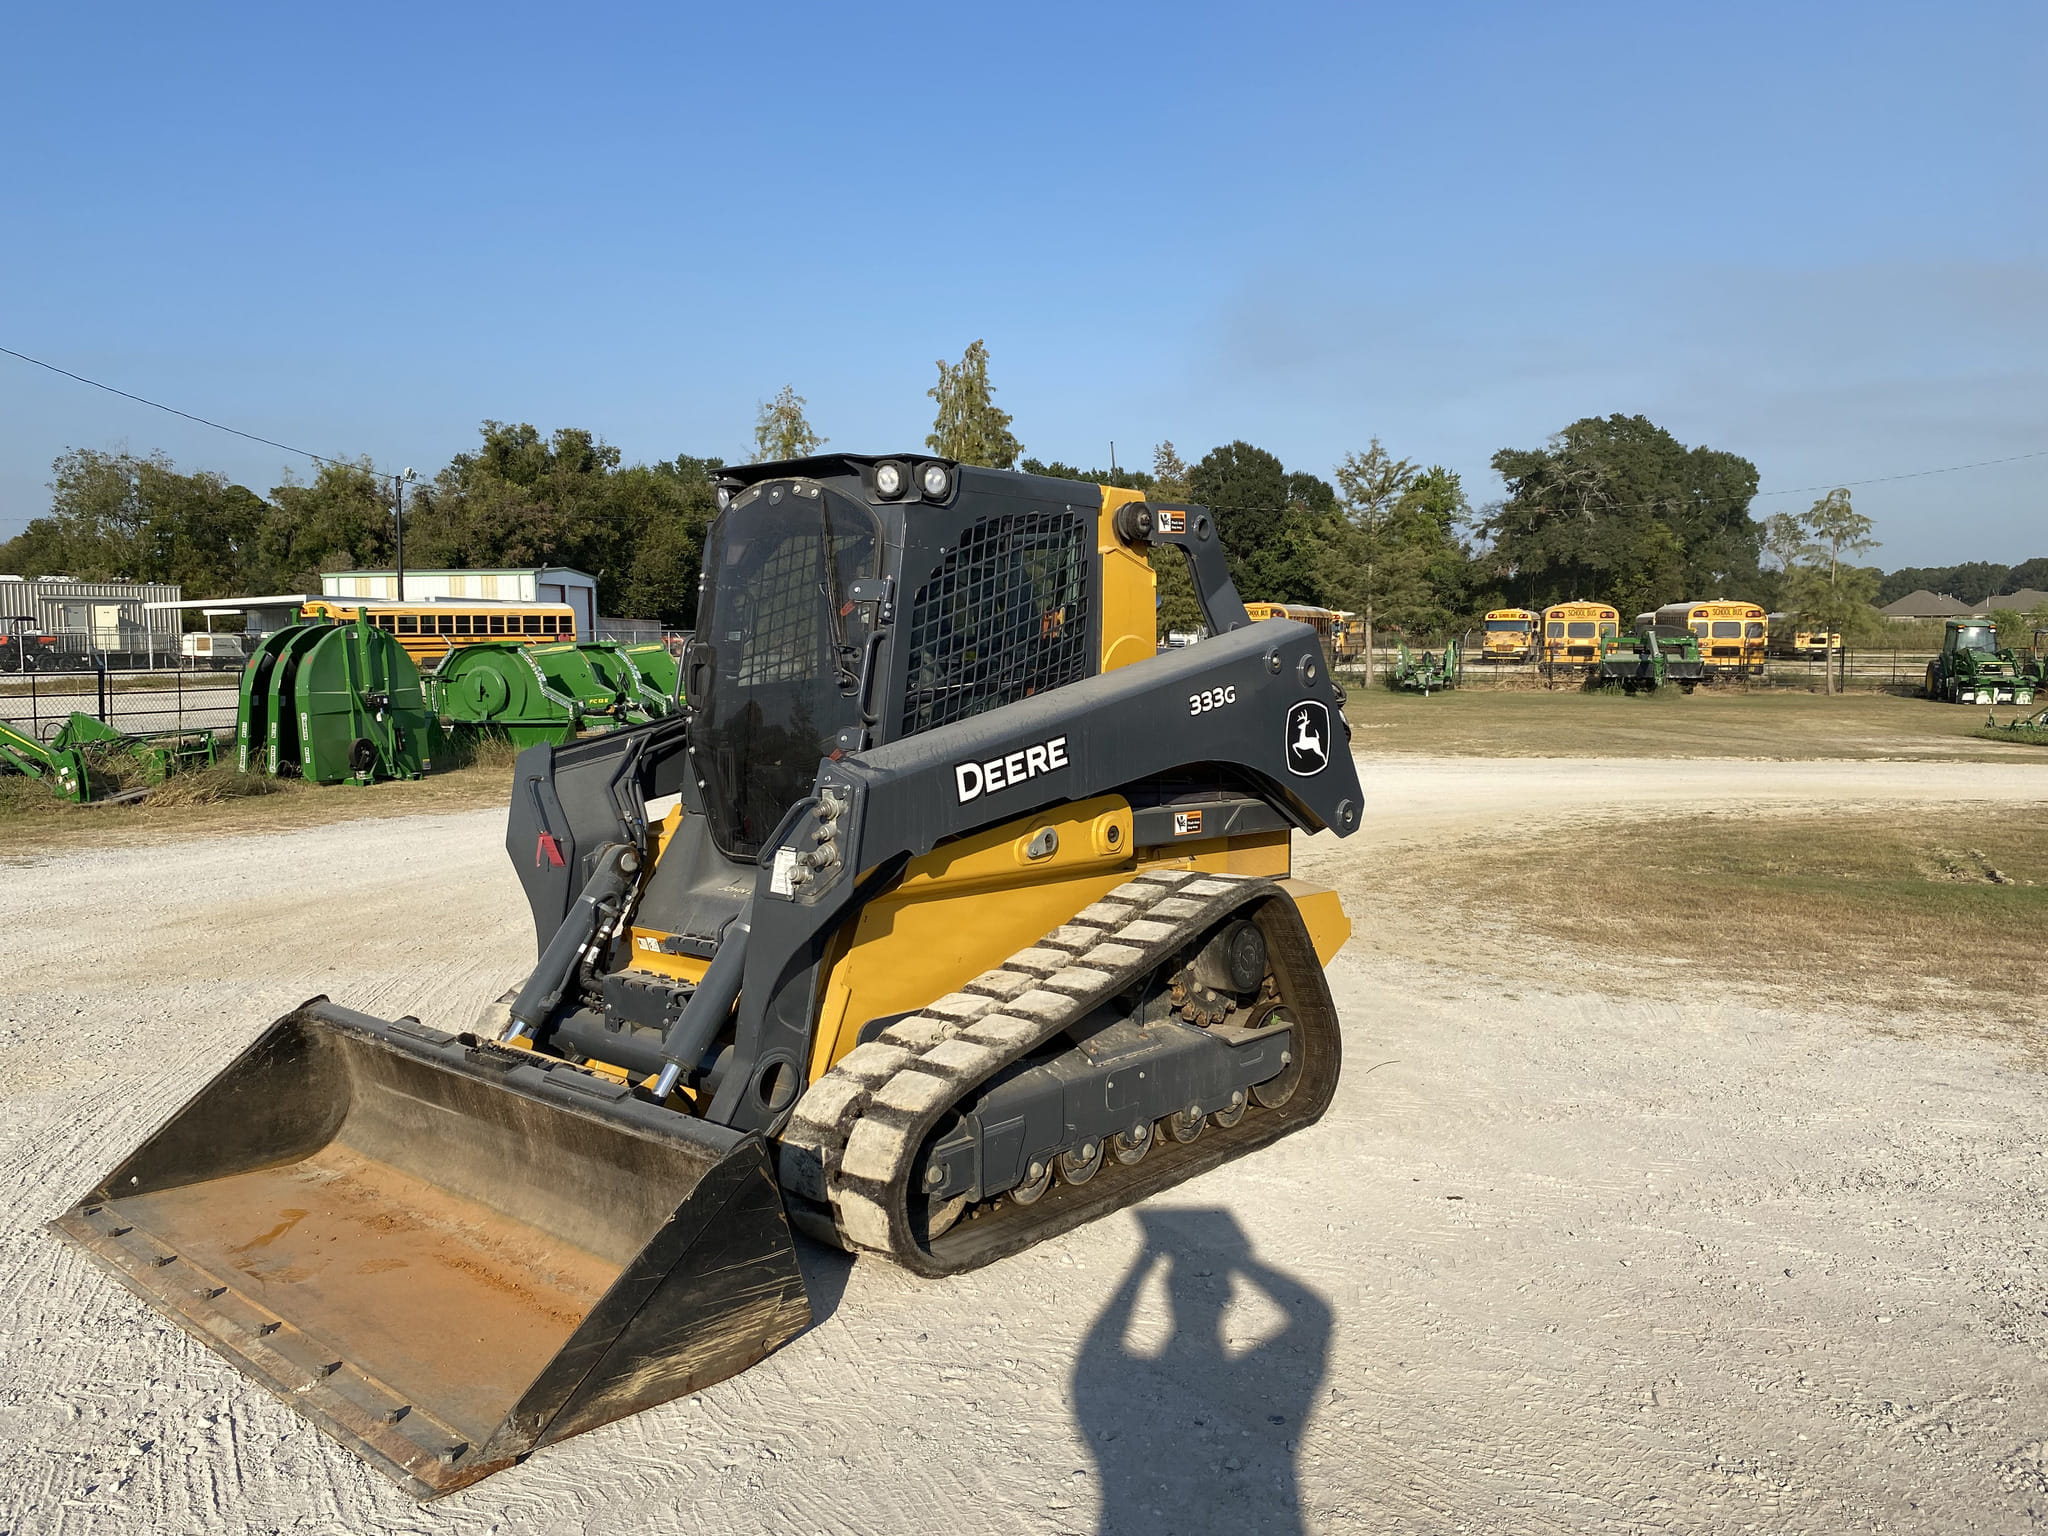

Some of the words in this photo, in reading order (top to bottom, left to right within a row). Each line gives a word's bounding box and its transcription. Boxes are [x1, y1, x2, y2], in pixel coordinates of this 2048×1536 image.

[1567, 609, 1586, 617] SCHOOL
[1587, 609, 1597, 617] BUS
[1712, 608, 1731, 616] SCHOOL
[1732, 608, 1743, 616] BUS
[1189, 685, 1236, 715] 333G
[954, 735, 1069, 803] DEERE
